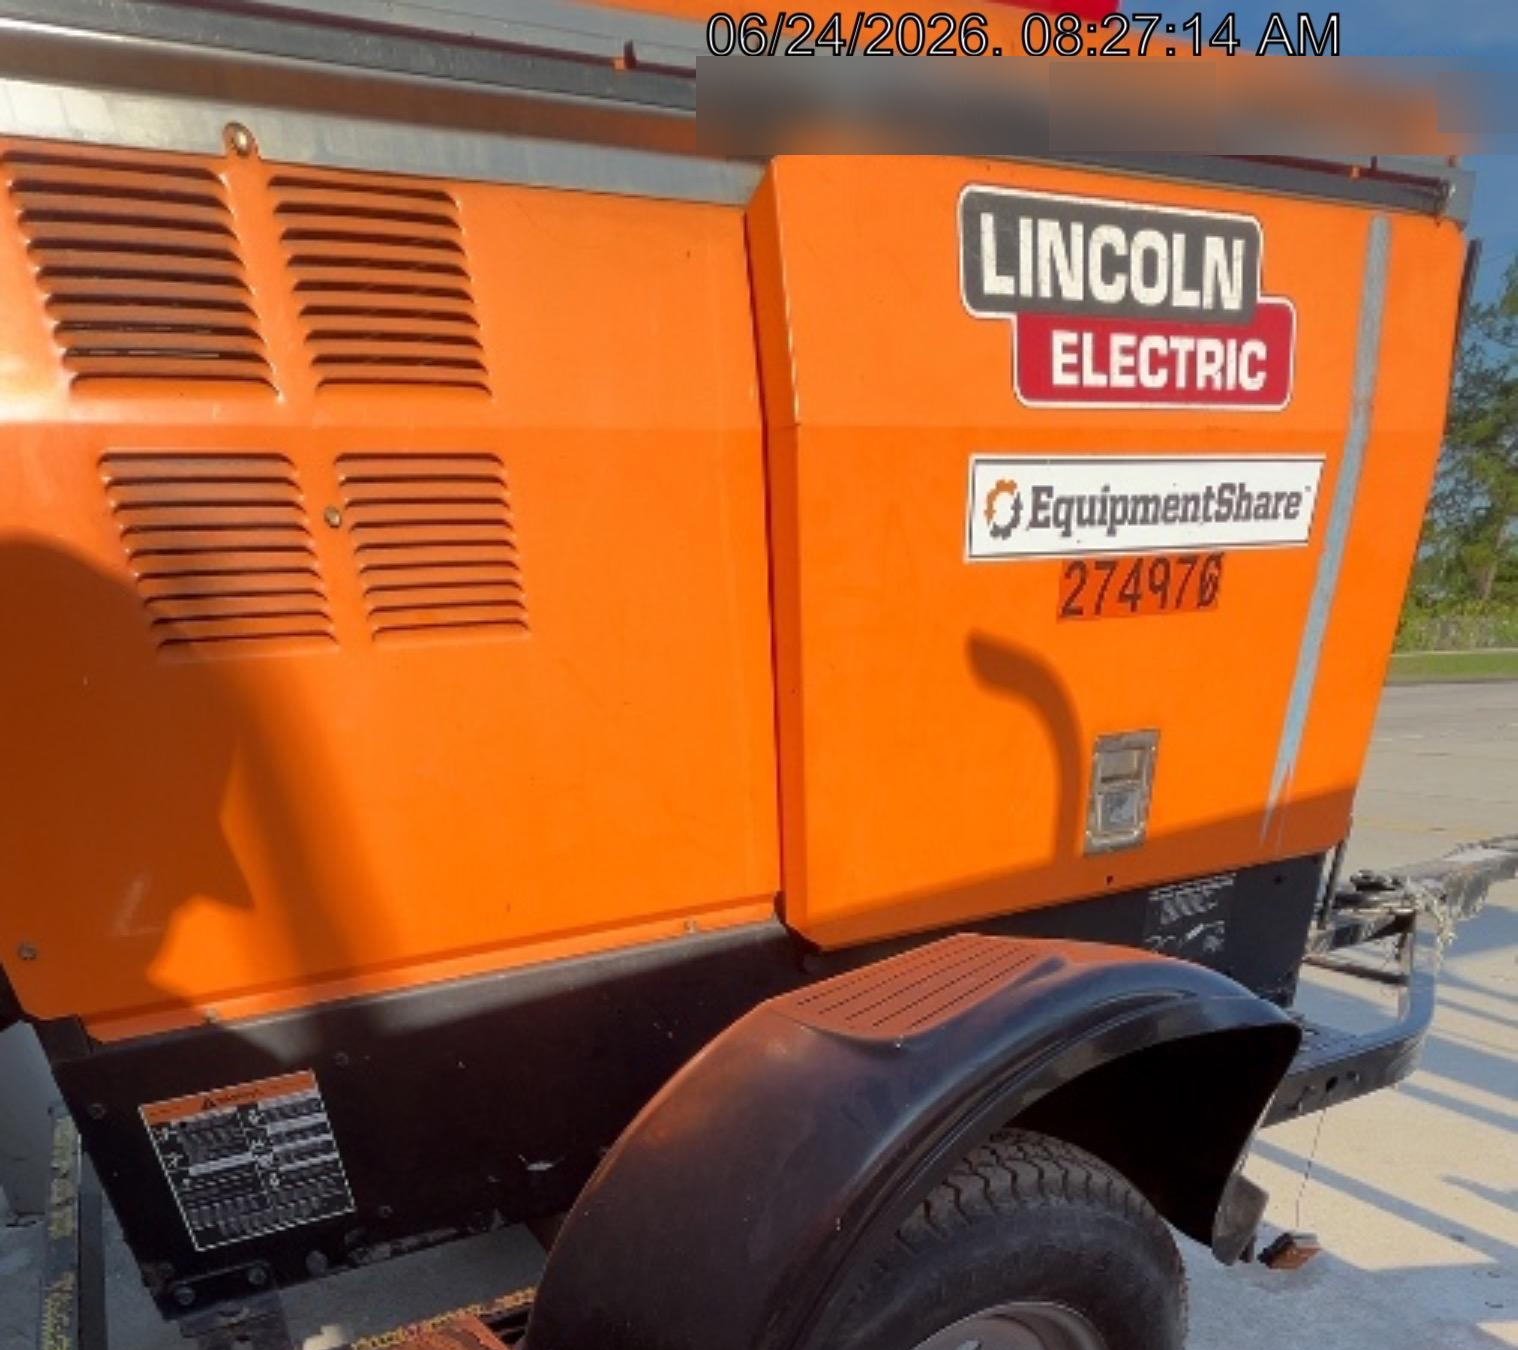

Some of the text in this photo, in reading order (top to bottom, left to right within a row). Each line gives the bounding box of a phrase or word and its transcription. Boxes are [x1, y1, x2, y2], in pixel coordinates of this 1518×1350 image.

[980, 212, 1245, 310] LINCOLN
[1052, 329, 1267, 391] ELECTRIC
[1028, 483, 1303, 538] EquipmentShare
